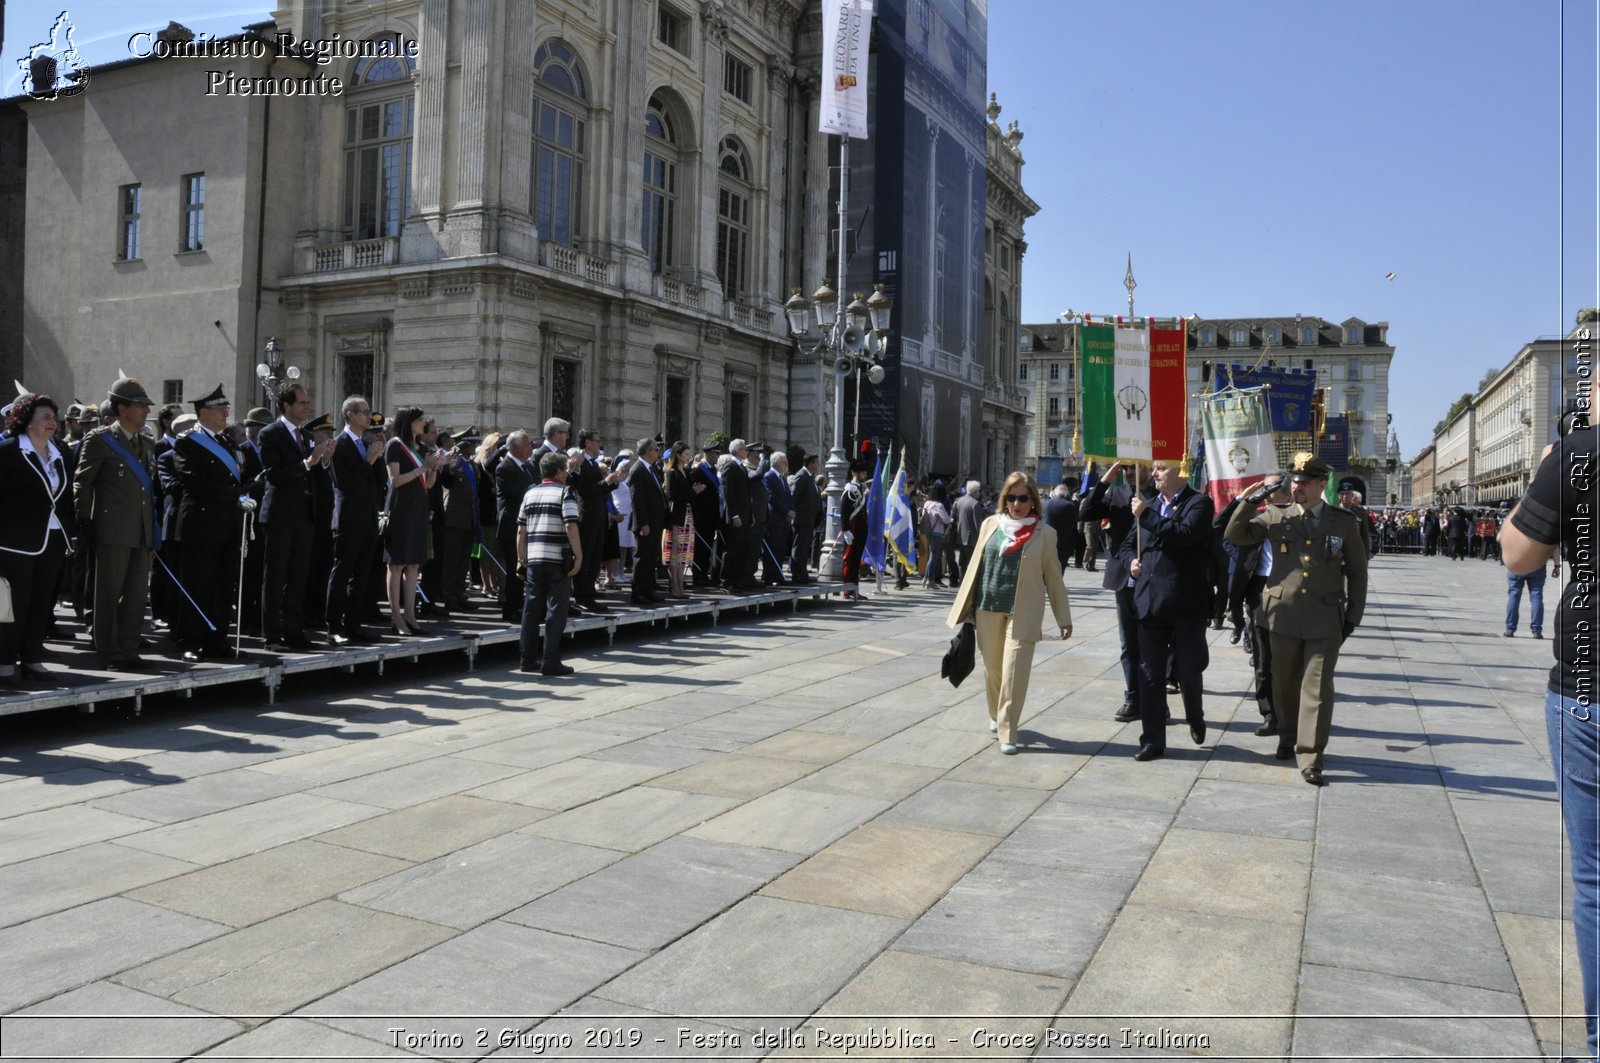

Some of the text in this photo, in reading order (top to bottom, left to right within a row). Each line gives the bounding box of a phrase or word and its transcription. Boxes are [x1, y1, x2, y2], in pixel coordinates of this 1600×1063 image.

[851, 14, 861, 51] VINCI
[849, 56, 858, 75] DA
[1141, 439, 1167, 448] TORINO
